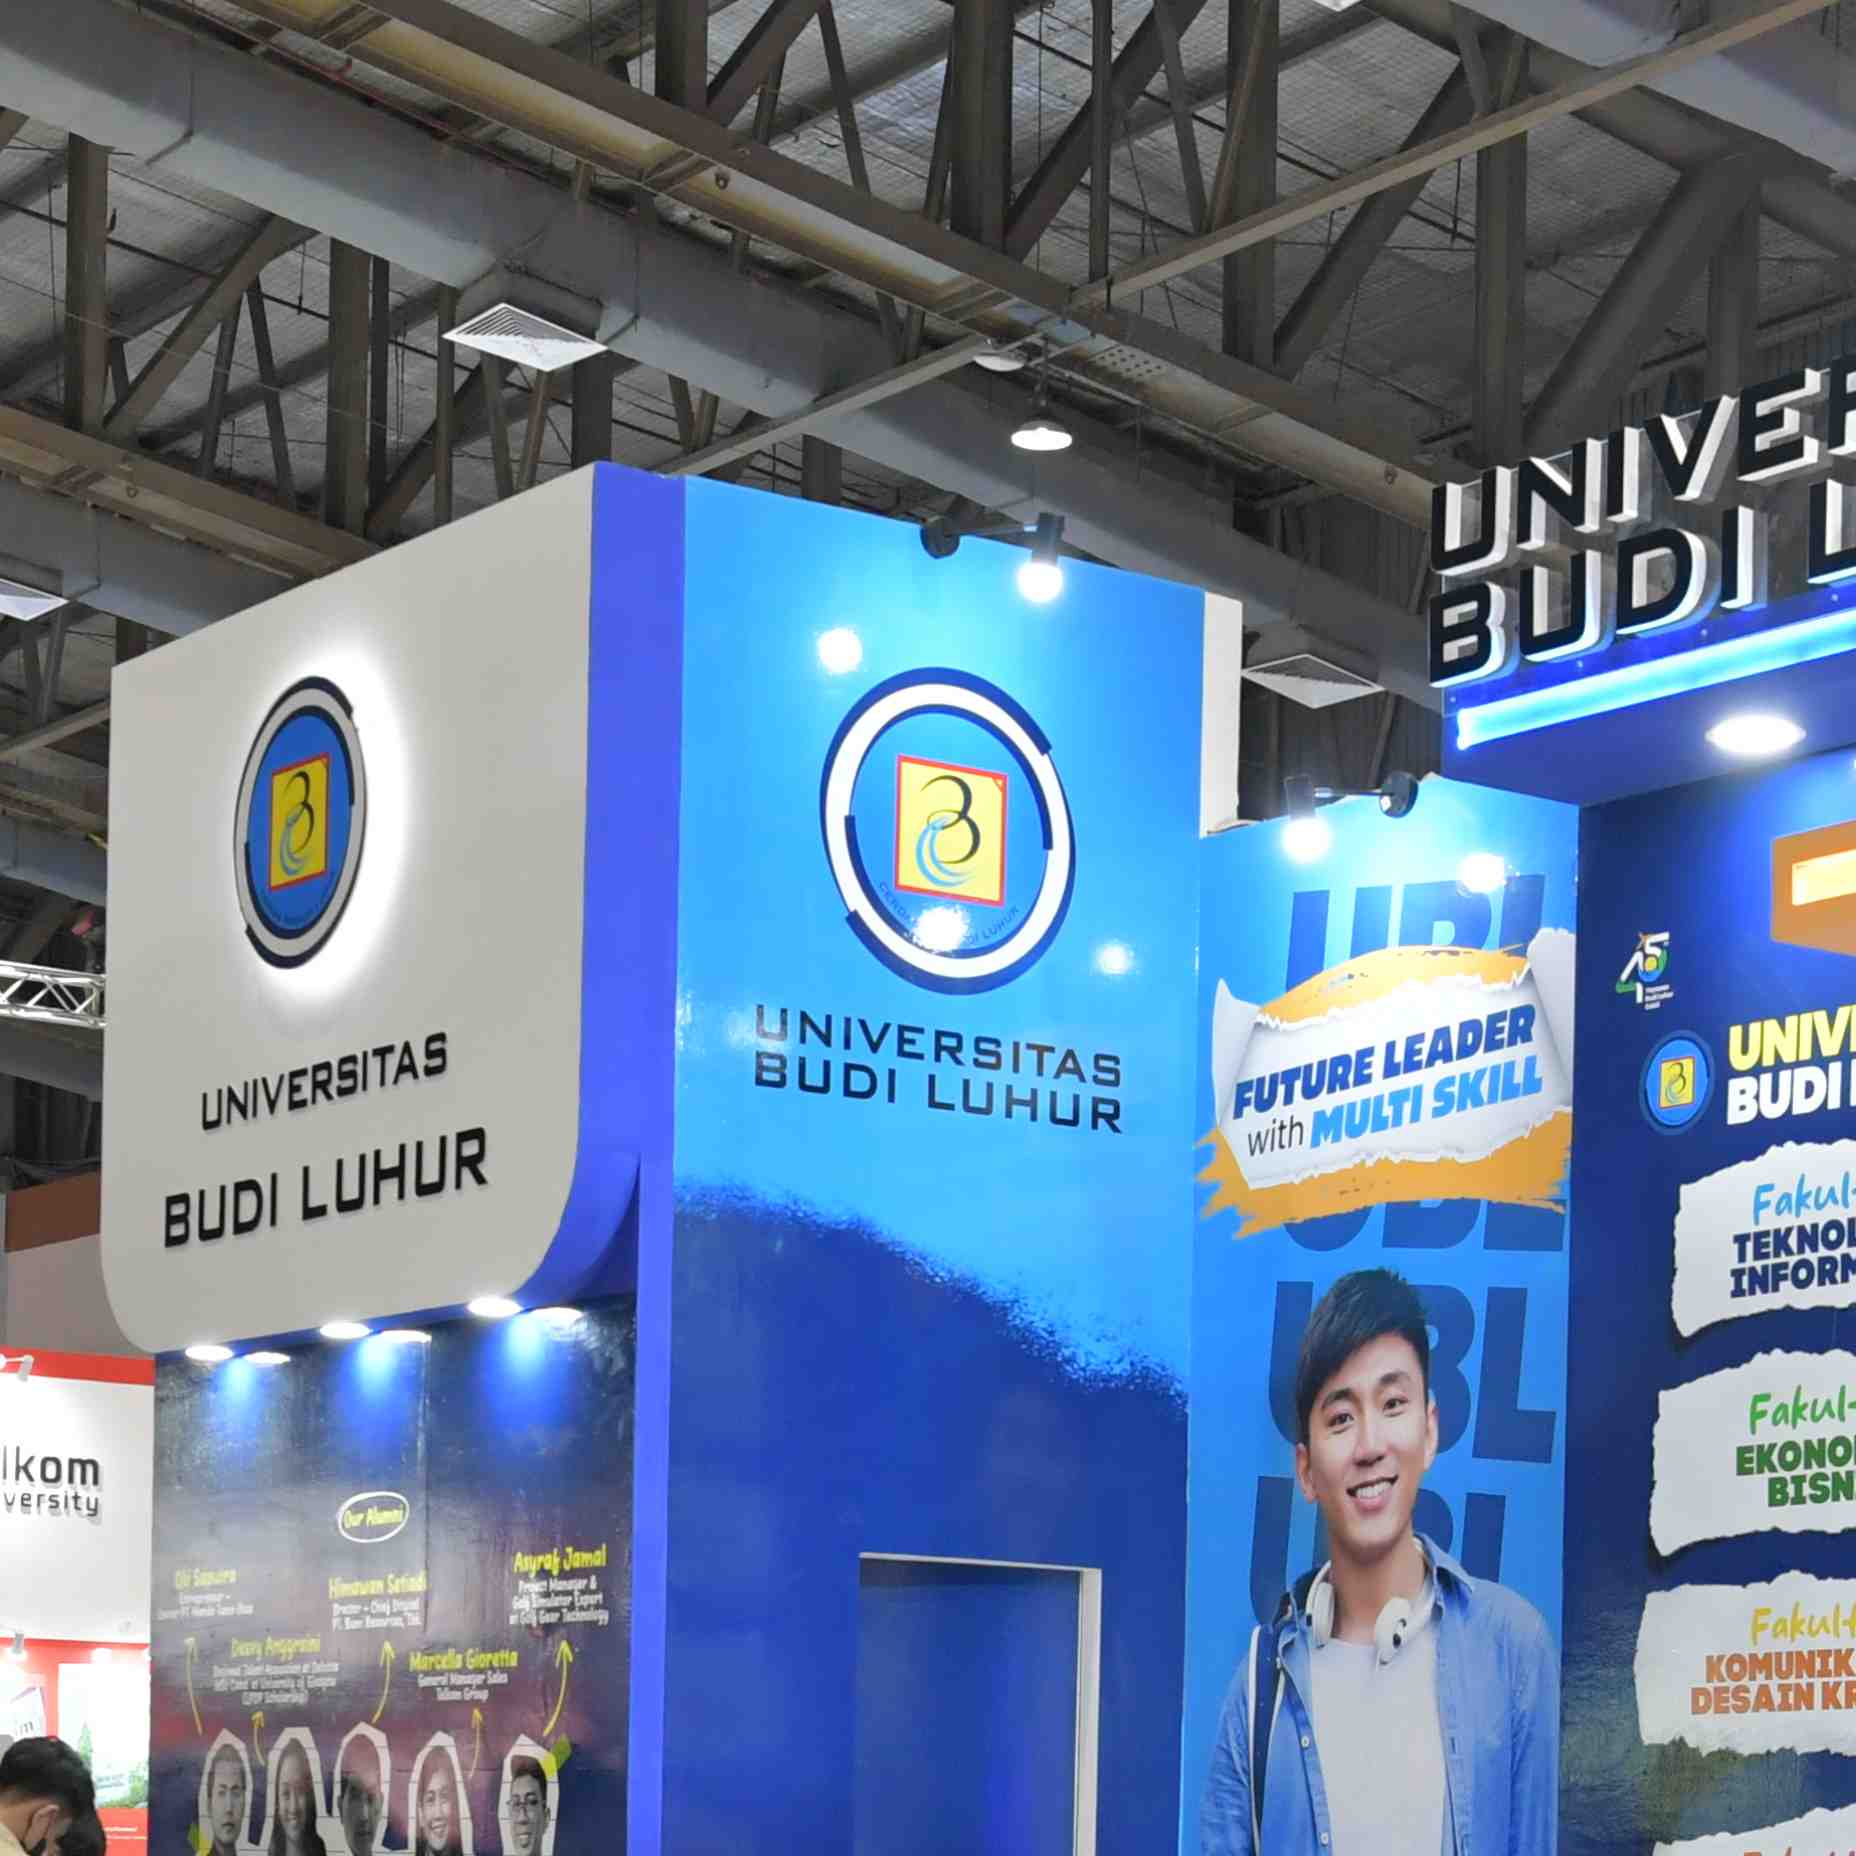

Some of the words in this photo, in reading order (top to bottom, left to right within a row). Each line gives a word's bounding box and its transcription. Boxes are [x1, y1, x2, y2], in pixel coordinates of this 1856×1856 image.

[1429, 507, 1756, 688] BUDI
[201, 1032, 448, 1131] UNIVERSITAS
[755, 1003, 1122, 1089] UNIVERSITAS
[755, 1050, 896, 1104] BUDI
[928, 1073, 1122, 1133] LUHUR
[1233, 1044, 1376, 1120] FUTURE
[1383, 1003, 1537, 1080] LEADER
[1727, 1056, 1841, 1126] BUDI
[1248, 1115, 1305, 1157] with
[1310, 1087, 1423, 1149] MULTI
[1432, 1055, 1542, 1121] SKILL
[164, 1171, 278, 1248] BUDI
[302, 1127, 489, 1222] LUHUR
[563, 1543, 608, 1571] Jamal
[1690, 1680, 1815, 1715] DESAIN
